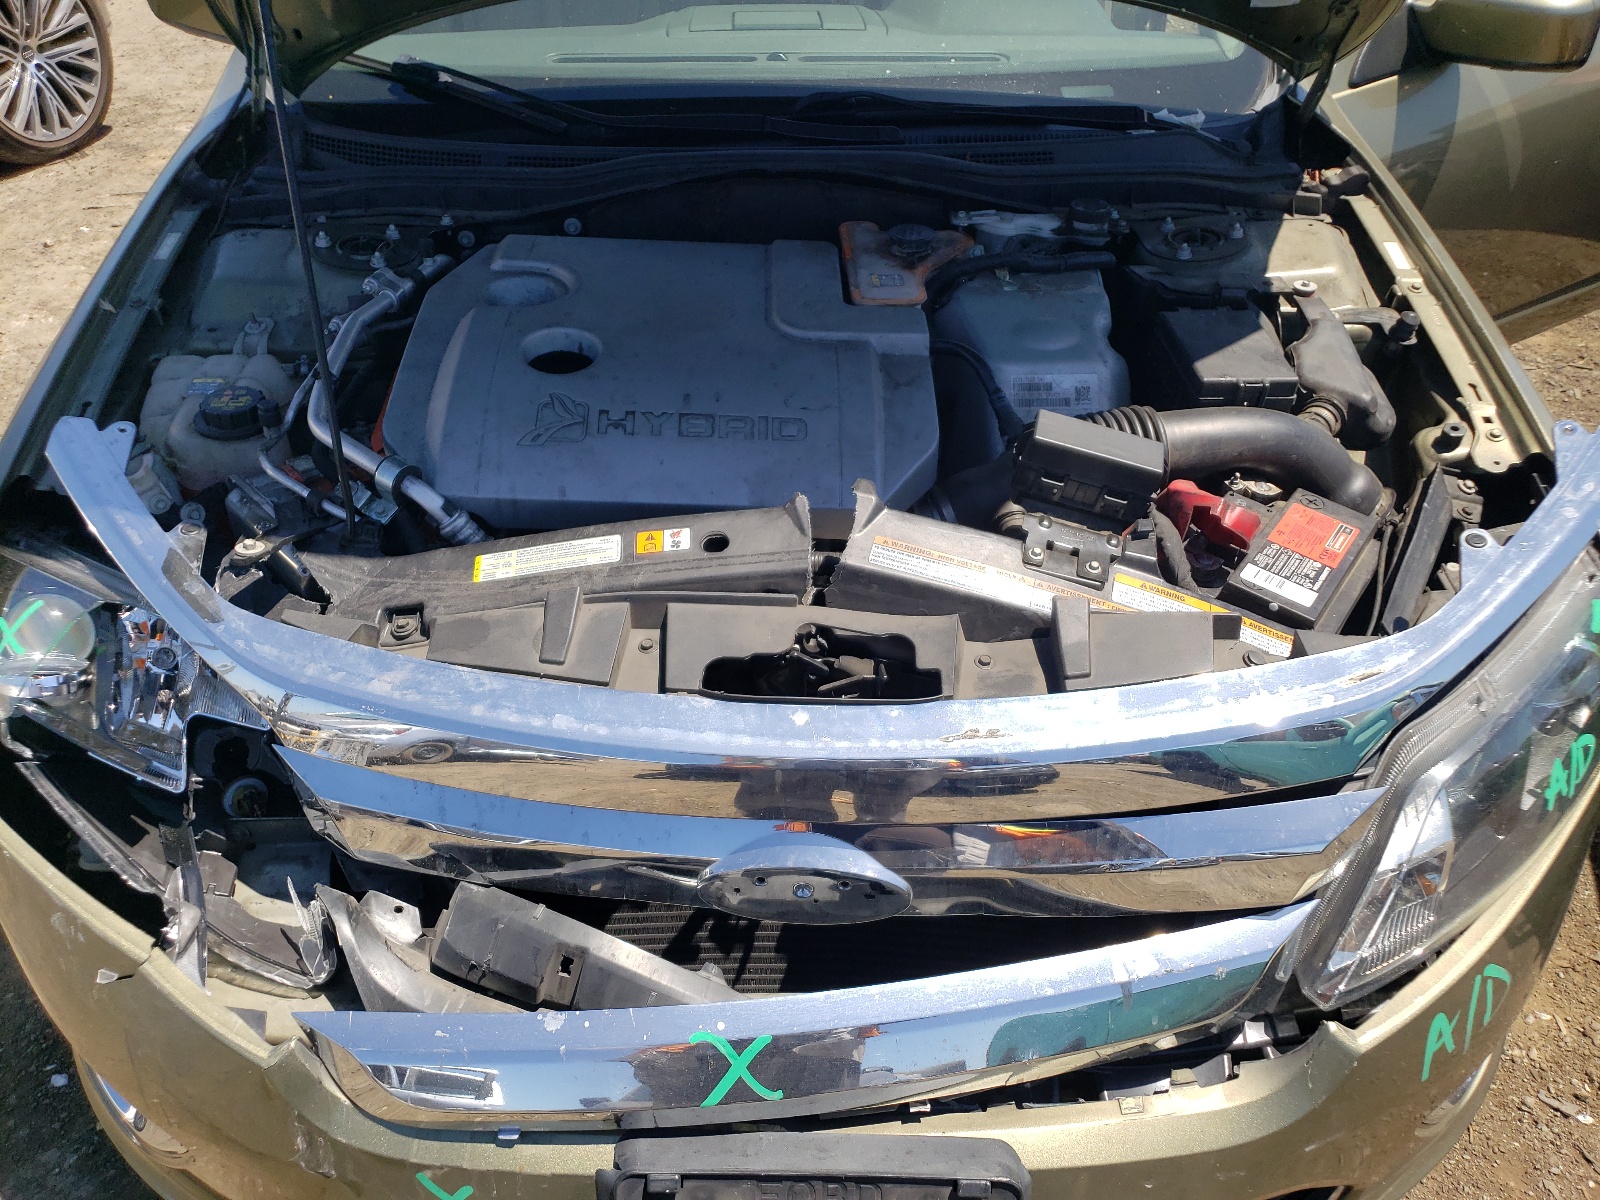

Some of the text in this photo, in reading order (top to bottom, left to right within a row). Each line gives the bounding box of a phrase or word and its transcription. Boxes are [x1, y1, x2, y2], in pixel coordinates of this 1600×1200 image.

[596, 408, 808, 442] HYBRID
[1149, 584, 1186, 603] WARNING
[688, 1030, 784, 1108] X
